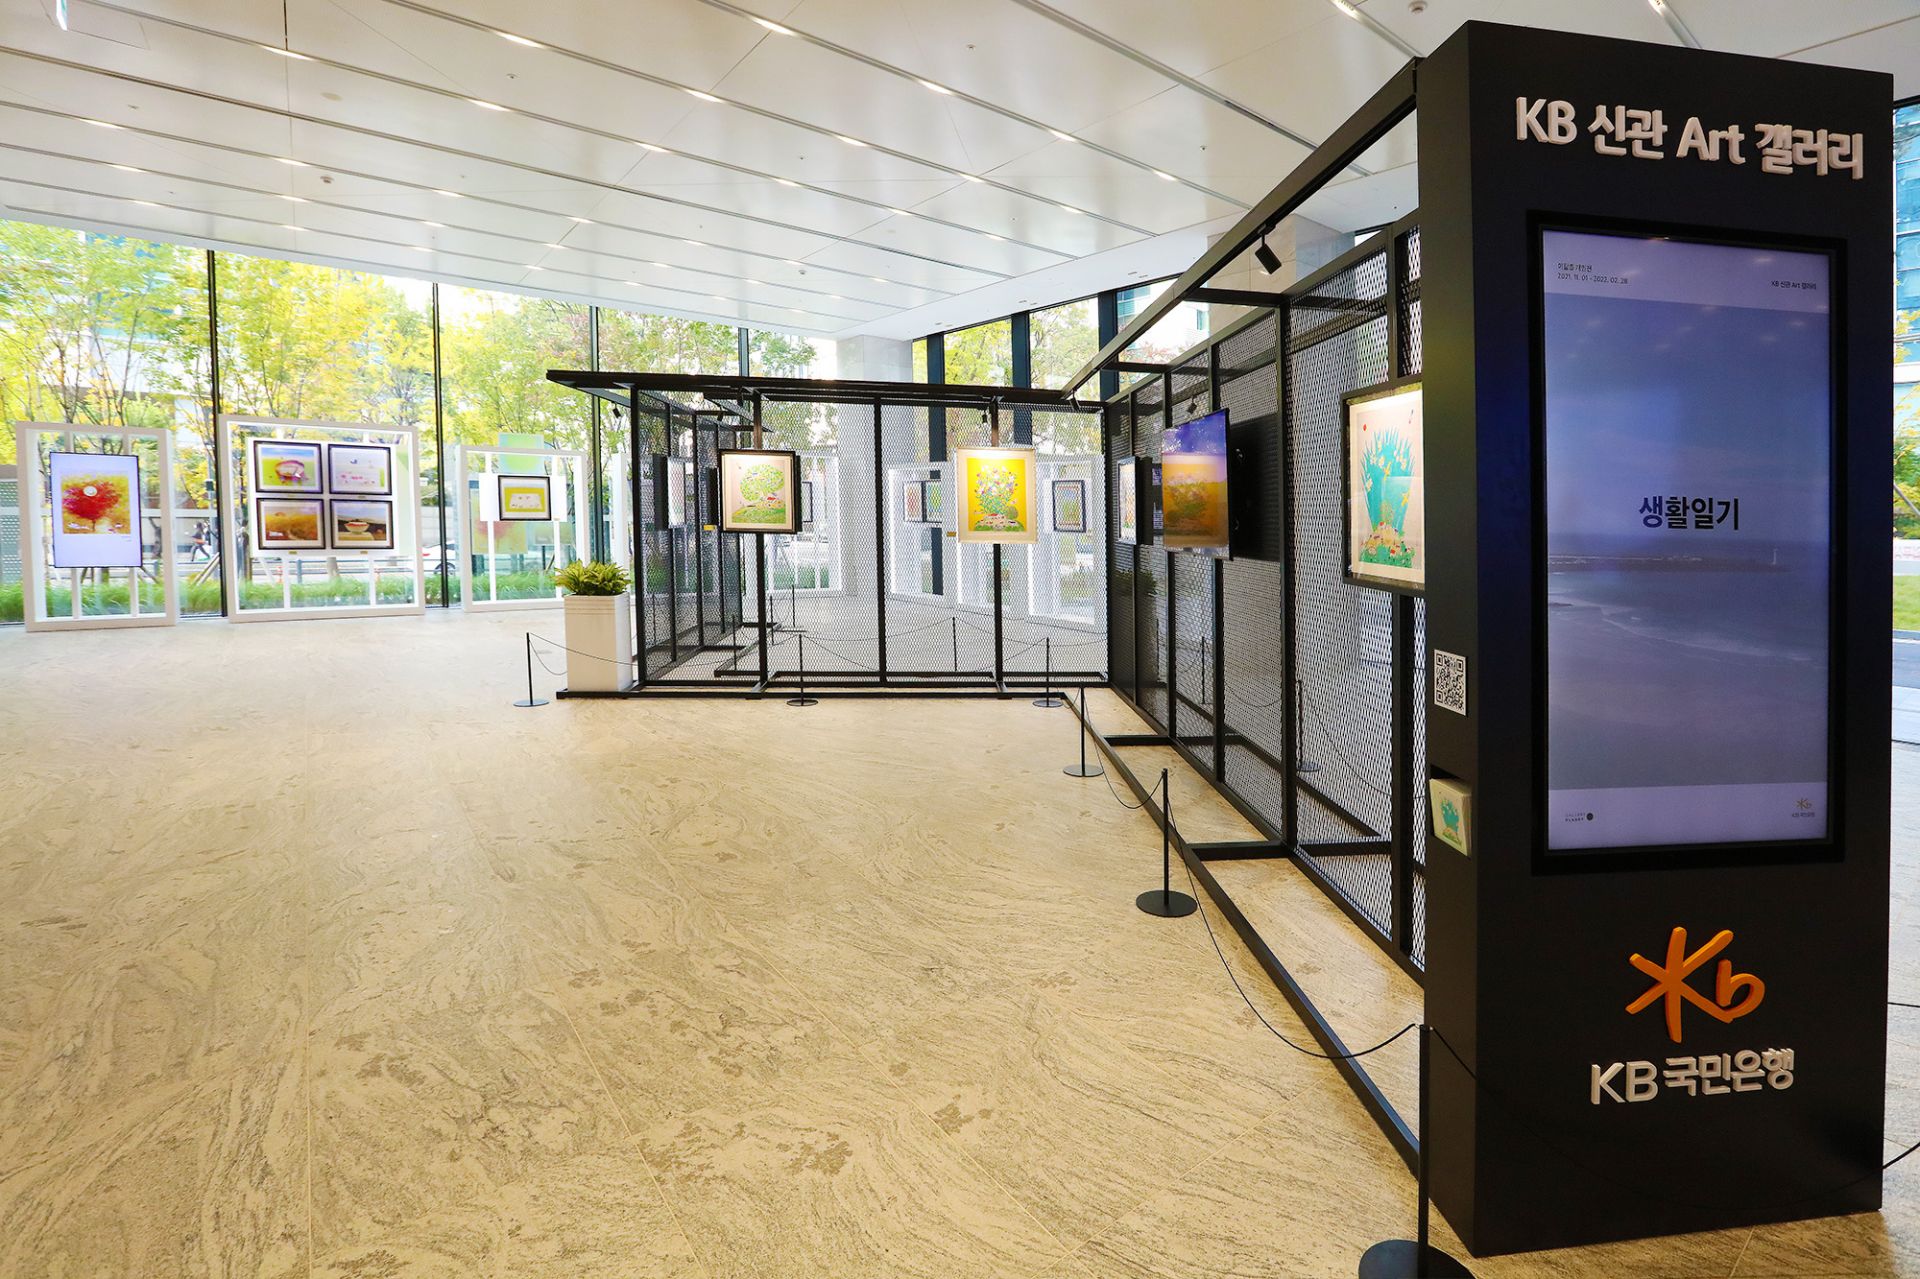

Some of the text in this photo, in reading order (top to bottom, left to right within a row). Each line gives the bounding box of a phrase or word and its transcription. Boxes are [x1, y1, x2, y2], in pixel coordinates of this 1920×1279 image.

[1516, 96, 1864, 180] KB 신관 Art 갤러리
[1639, 495, 1739, 531] 생활일기
